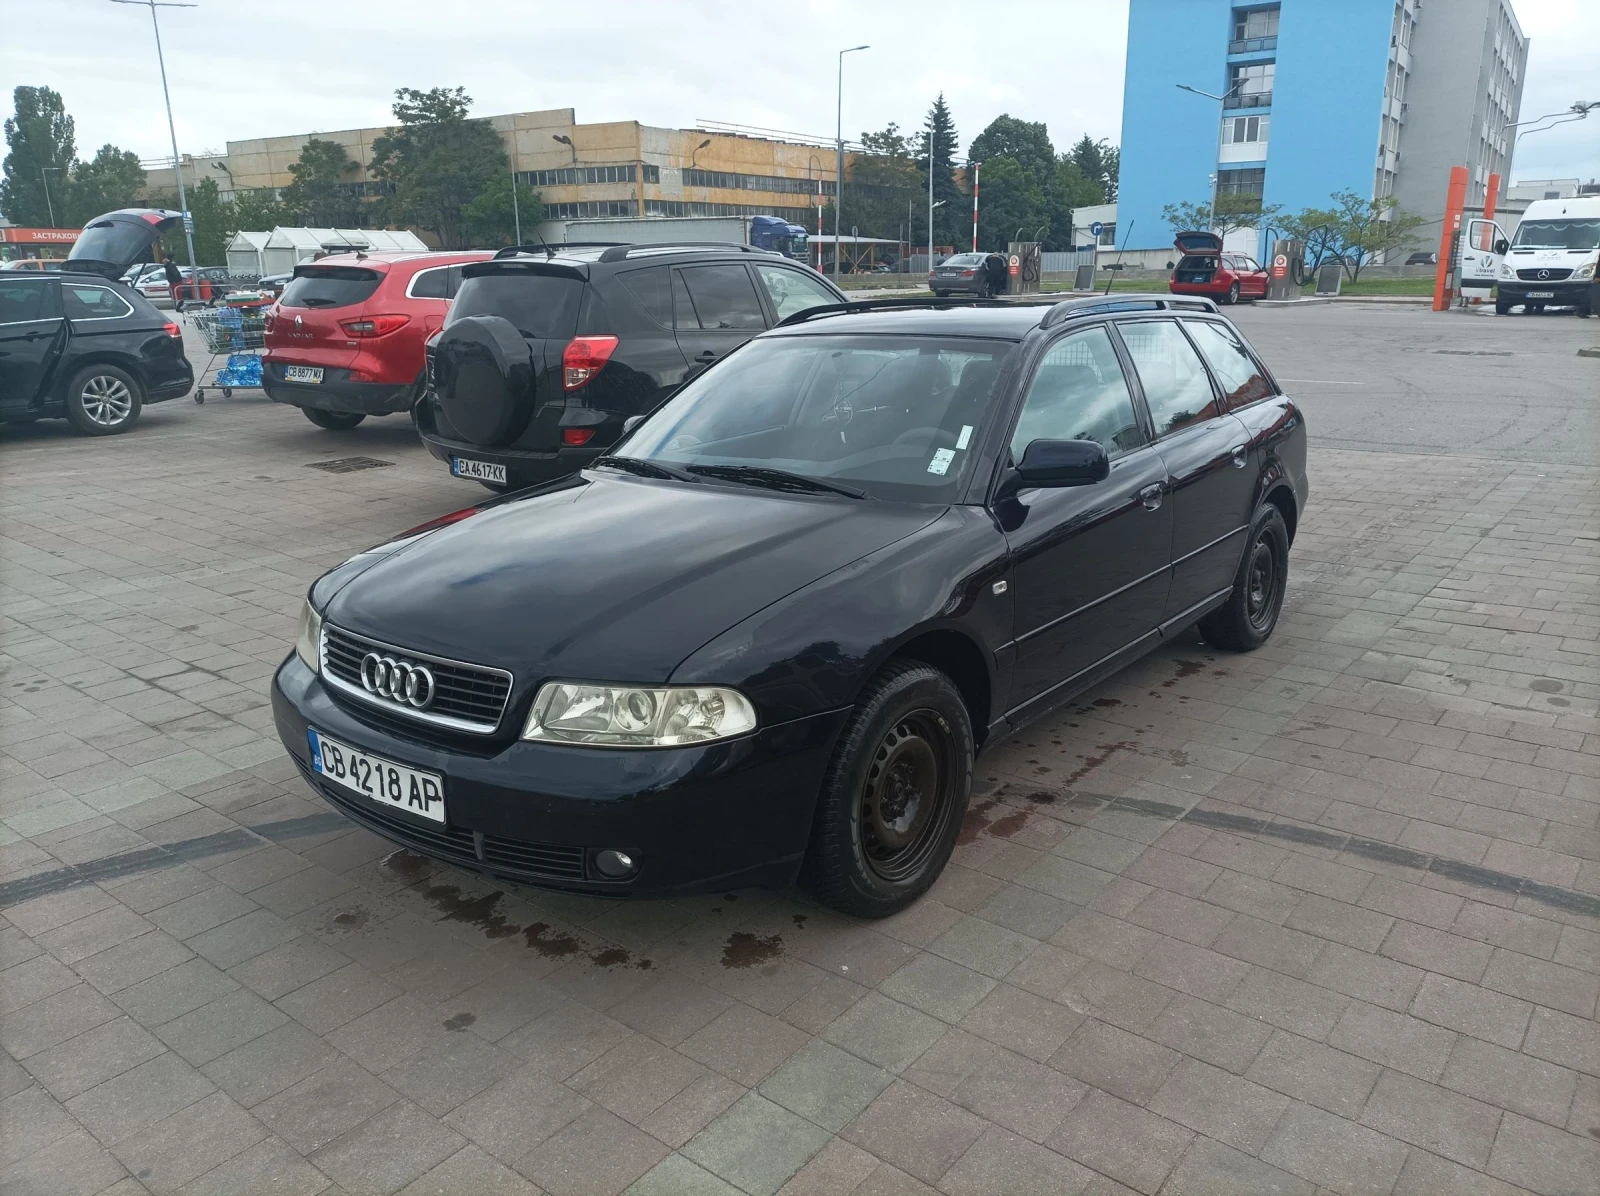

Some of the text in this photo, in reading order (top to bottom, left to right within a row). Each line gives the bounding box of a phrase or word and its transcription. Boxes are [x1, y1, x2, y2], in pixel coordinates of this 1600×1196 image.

[320, 741, 442, 812] CB 4218 AP
